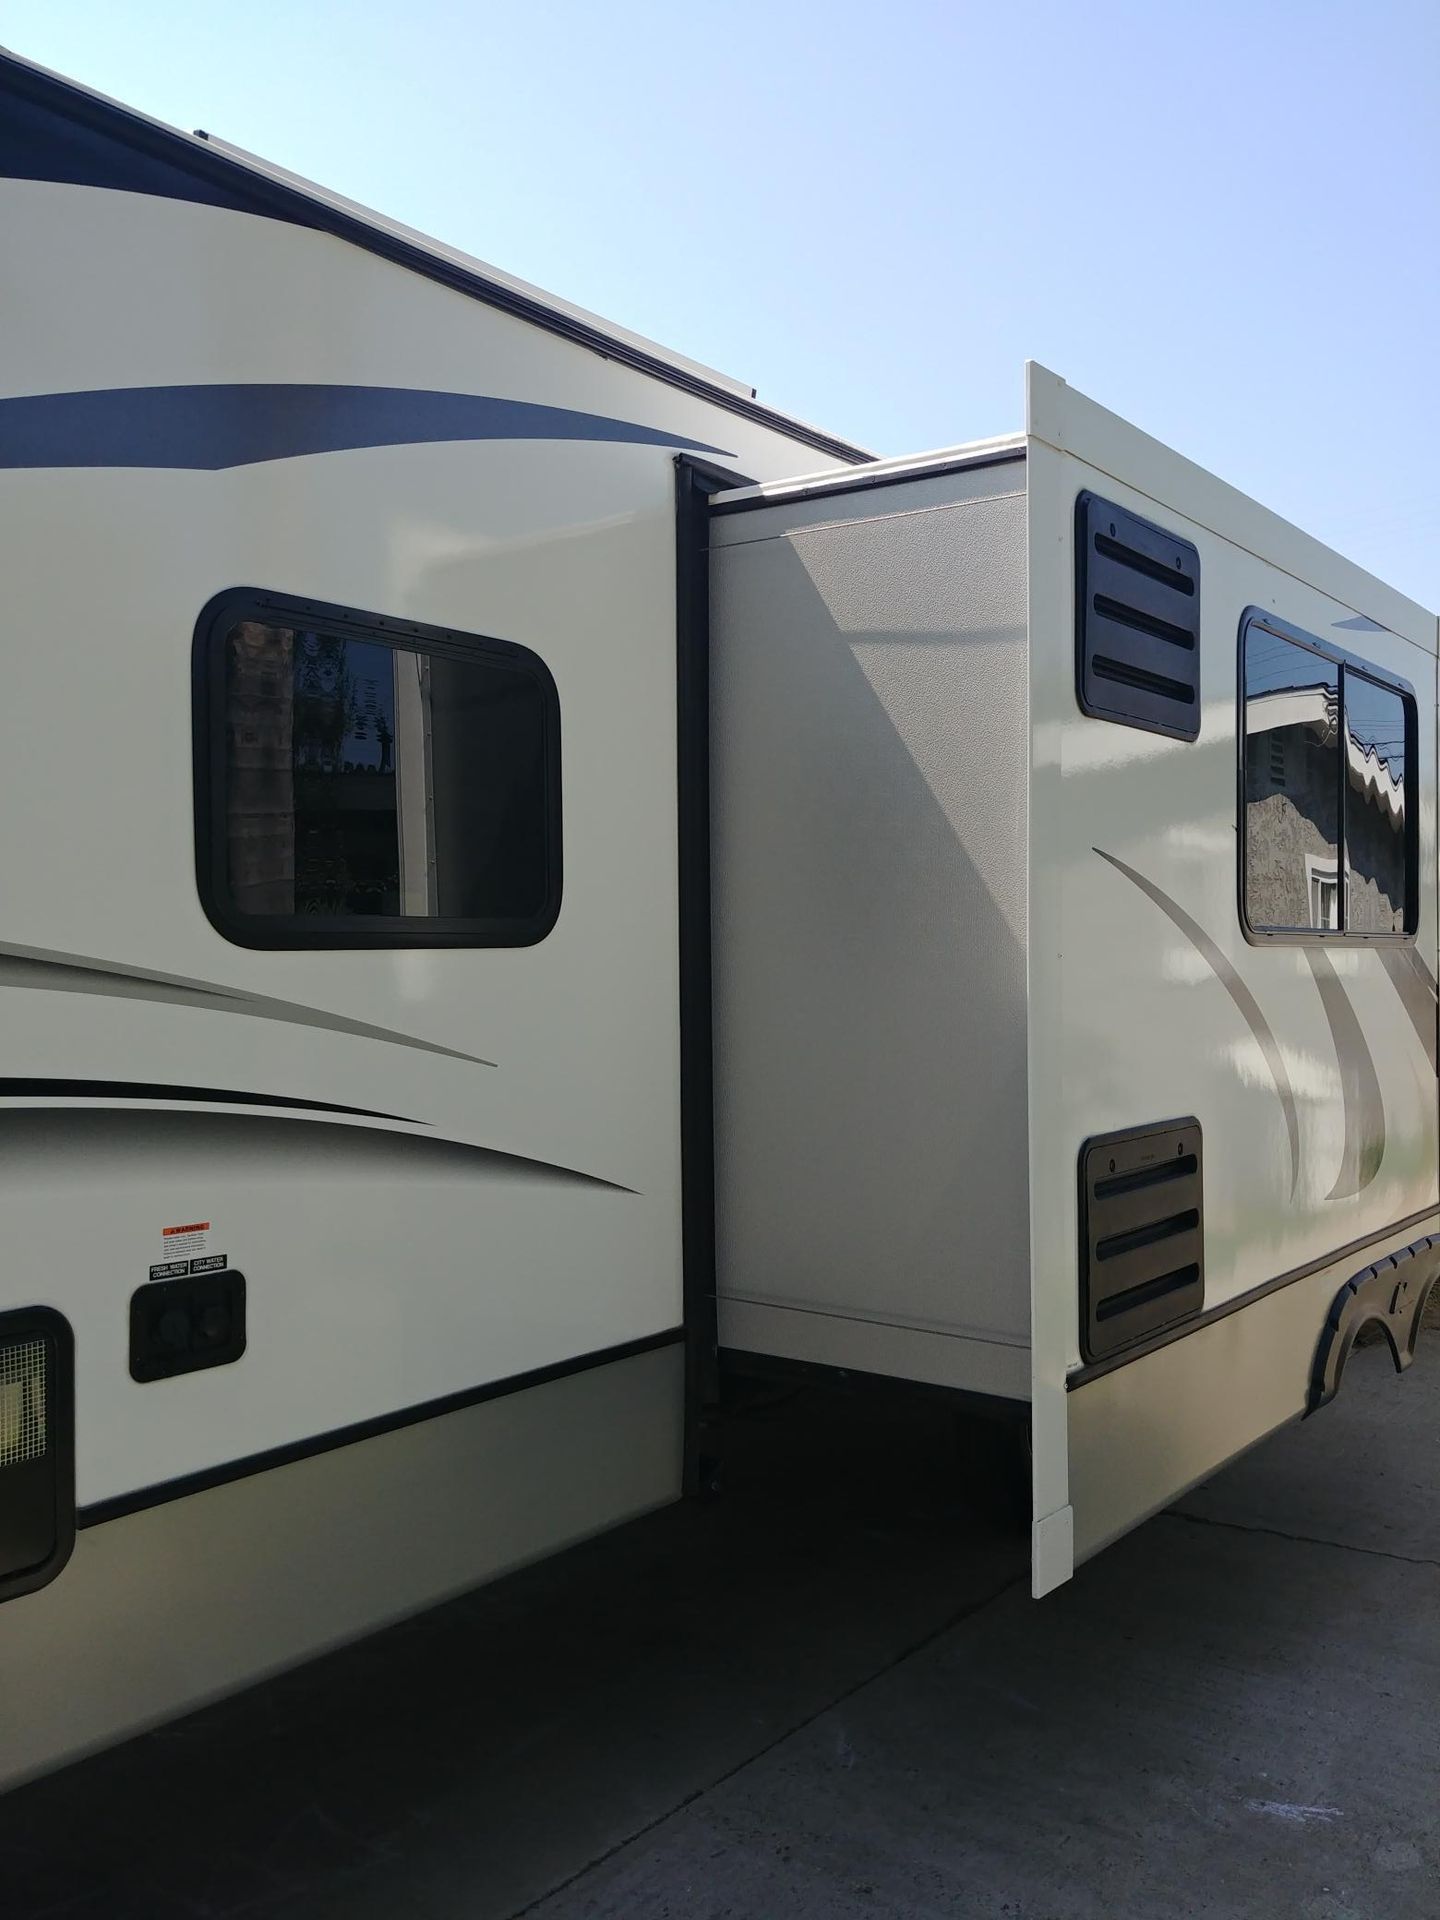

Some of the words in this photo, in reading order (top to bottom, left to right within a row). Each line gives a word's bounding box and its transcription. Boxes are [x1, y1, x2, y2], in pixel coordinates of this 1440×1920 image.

[206, 1256, 224, 1264] WATER
[151, 1265, 169, 1273] FRESH
[169, 1262, 188, 1270] WATER
[193, 1262, 224, 1272] CONNECTION
[152, 1268, 186, 1278] CONNECTION
